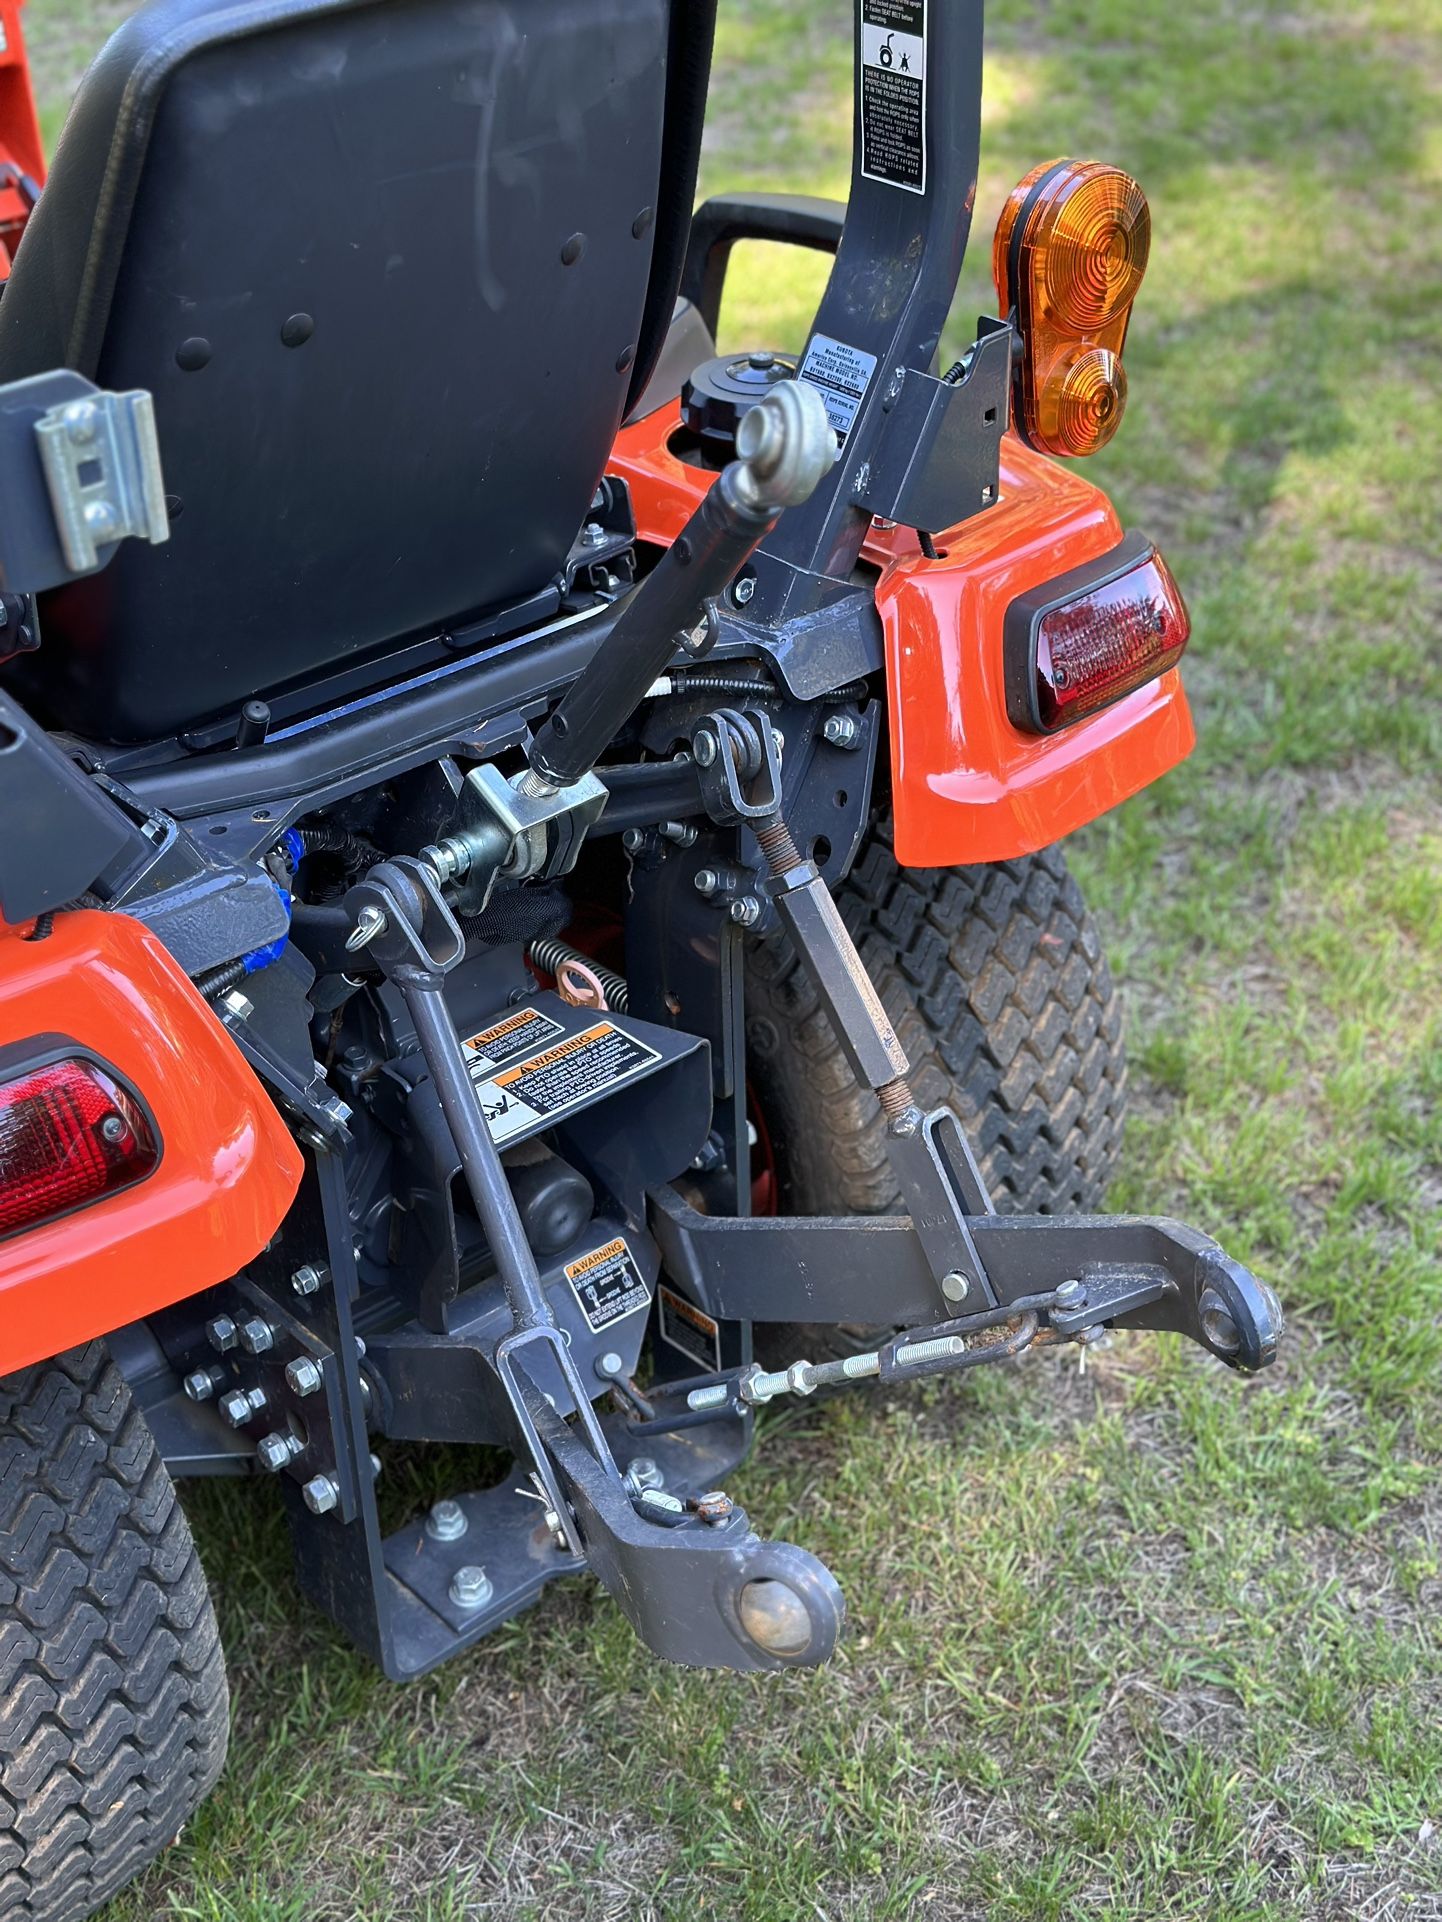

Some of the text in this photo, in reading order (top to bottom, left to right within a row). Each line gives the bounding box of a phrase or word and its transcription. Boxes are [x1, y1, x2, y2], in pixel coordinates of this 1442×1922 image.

[812, 352, 827, 360] America
[824, 349, 855, 364] Manufacturing
[836, 346, 853, 356] KUBOTA
[815, 361, 835, 371] MACHINE
[835, 368, 850, 377] MODEL
[483, 1012, 536, 1040] WARNING
[531, 1035, 592, 1068] WARNING
[544, 1070, 569, 1083] operate
[577, 1057, 593, 1066] PTO
[598, 1043, 622, 1055] speeds
[514, 1074, 534, 1085] AVOID
[533, 1058, 567, 1075] PERSONAL
[564, 1047, 588, 1059] INJURY
[518, 1080, 536, 1090] Keep
[535, 1073, 551, 1081] PTO
[549, 1064, 569, 1074] shield
[574, 1052, 593, 1062] place
[528, 1086, 547, 1096] faster
[545, 1079, 561, 1088] than
[570, 1064, 592, 1076] speed
[589, 1044, 632, 1065] recommended
[549, 1086, 572, 1098] trailing
[569, 1069, 605, 1087] PTO-driven
[552, 1073, 585, 1090] implement
[552, 1092, 570, 1101] hitch
[575, 1079, 597, 1090] towing
[547, 1101, 564, 1110] (see
[561, 1086, 594, 1103] operator's
[579, 1242, 622, 1270] WARNING
